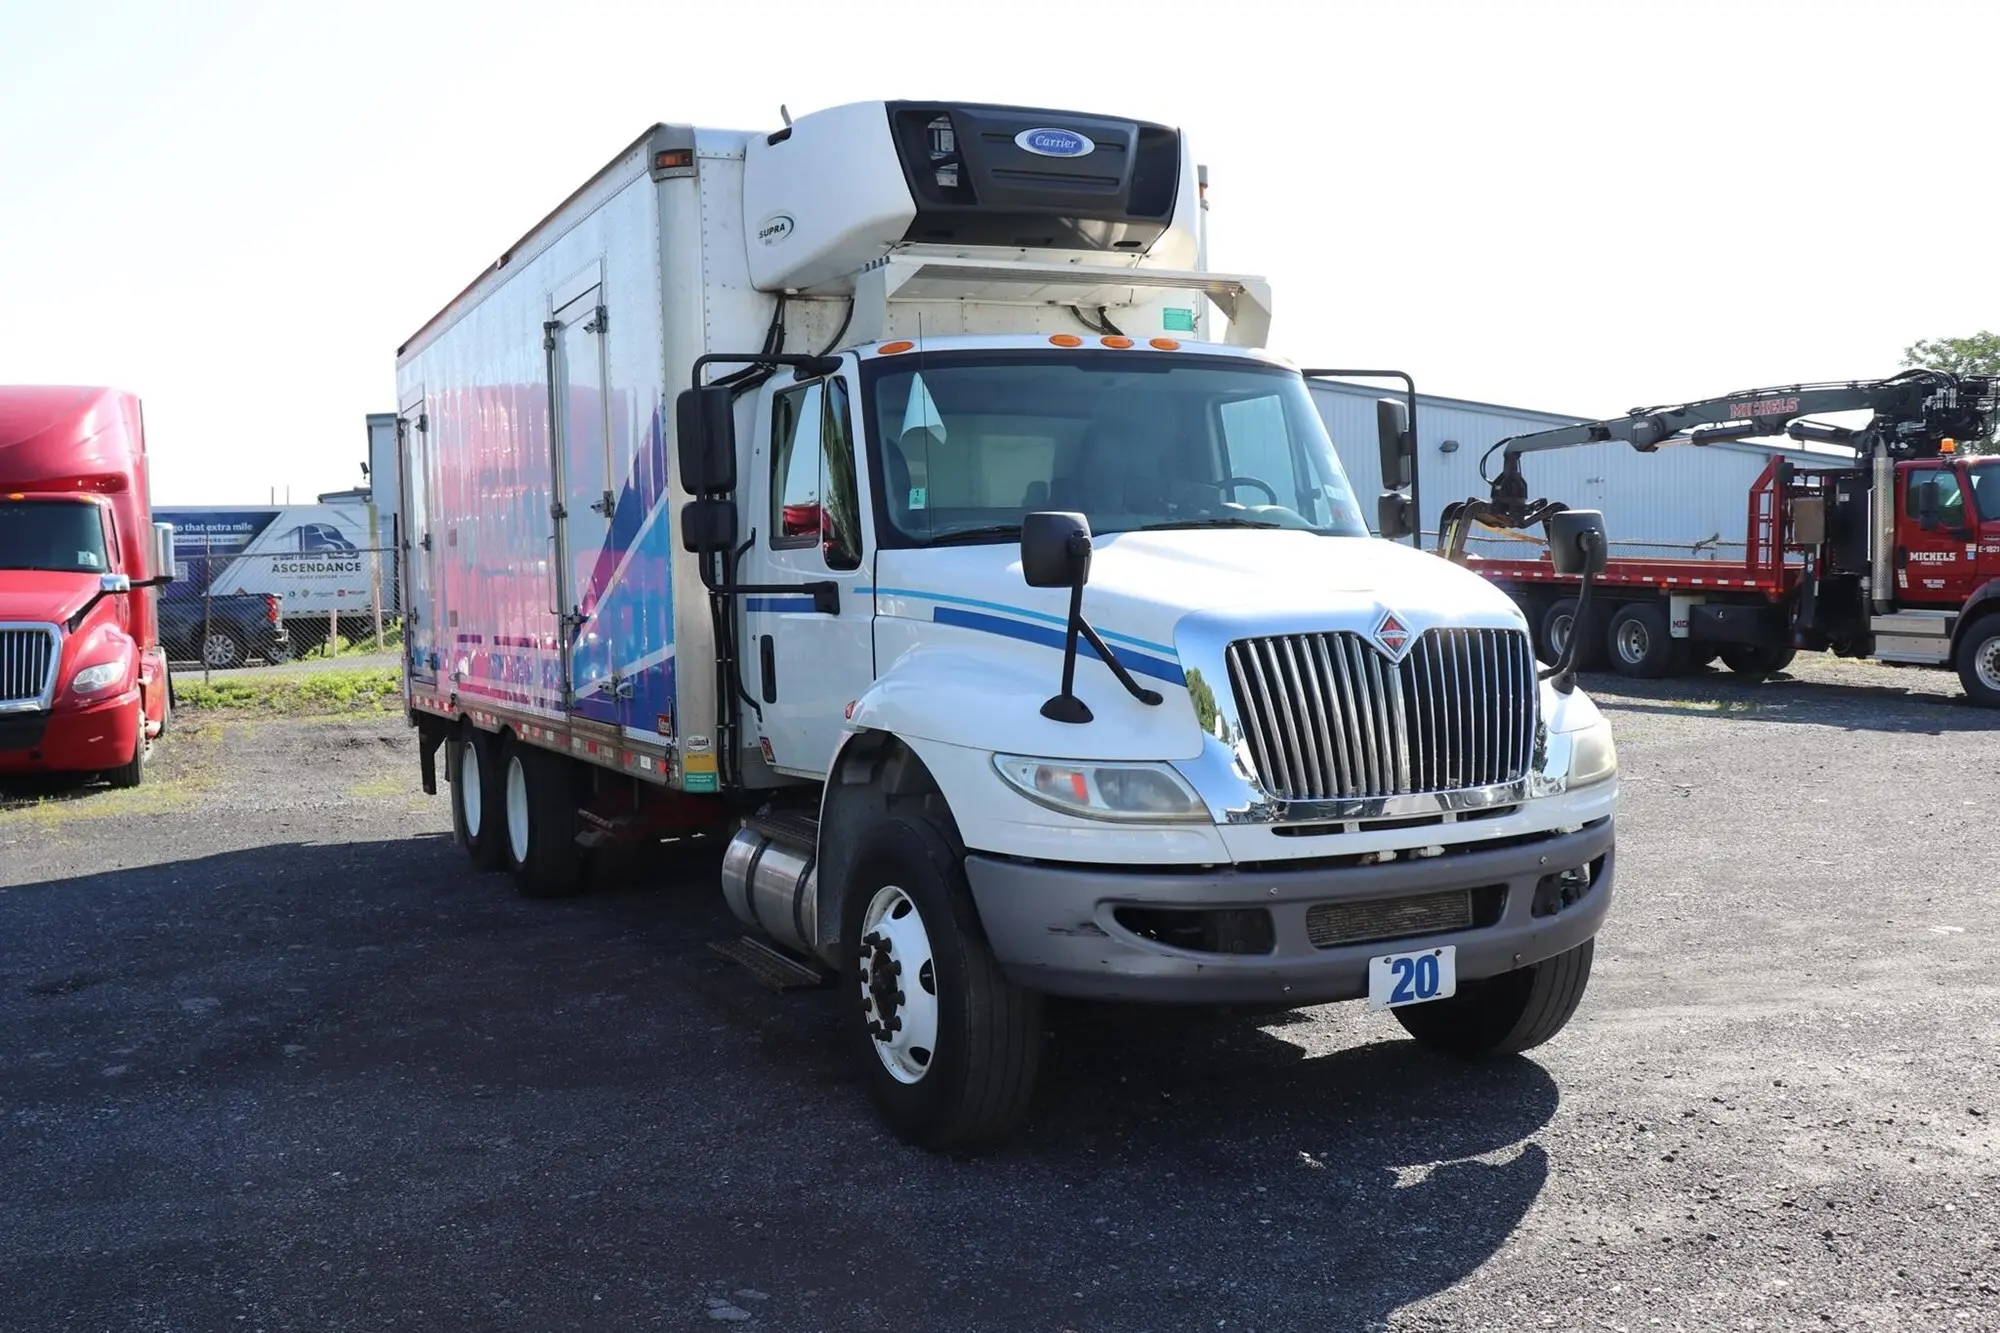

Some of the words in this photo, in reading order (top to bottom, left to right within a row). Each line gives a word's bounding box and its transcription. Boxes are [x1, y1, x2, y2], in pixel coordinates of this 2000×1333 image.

[1034, 135, 1077, 149] Carrier
[759, 223, 785, 239] SUPRA
[1729, 397, 1799, 419] MICHELS
[185, 523, 206, 532] that
[206, 523, 231, 532] extra
[232, 522, 253, 531] mile
[1909, 552, 1957, 561] MICHELS
[271, 562, 362, 573] ASCENDANCE
[1390, 954, 1440, 1004] 20
